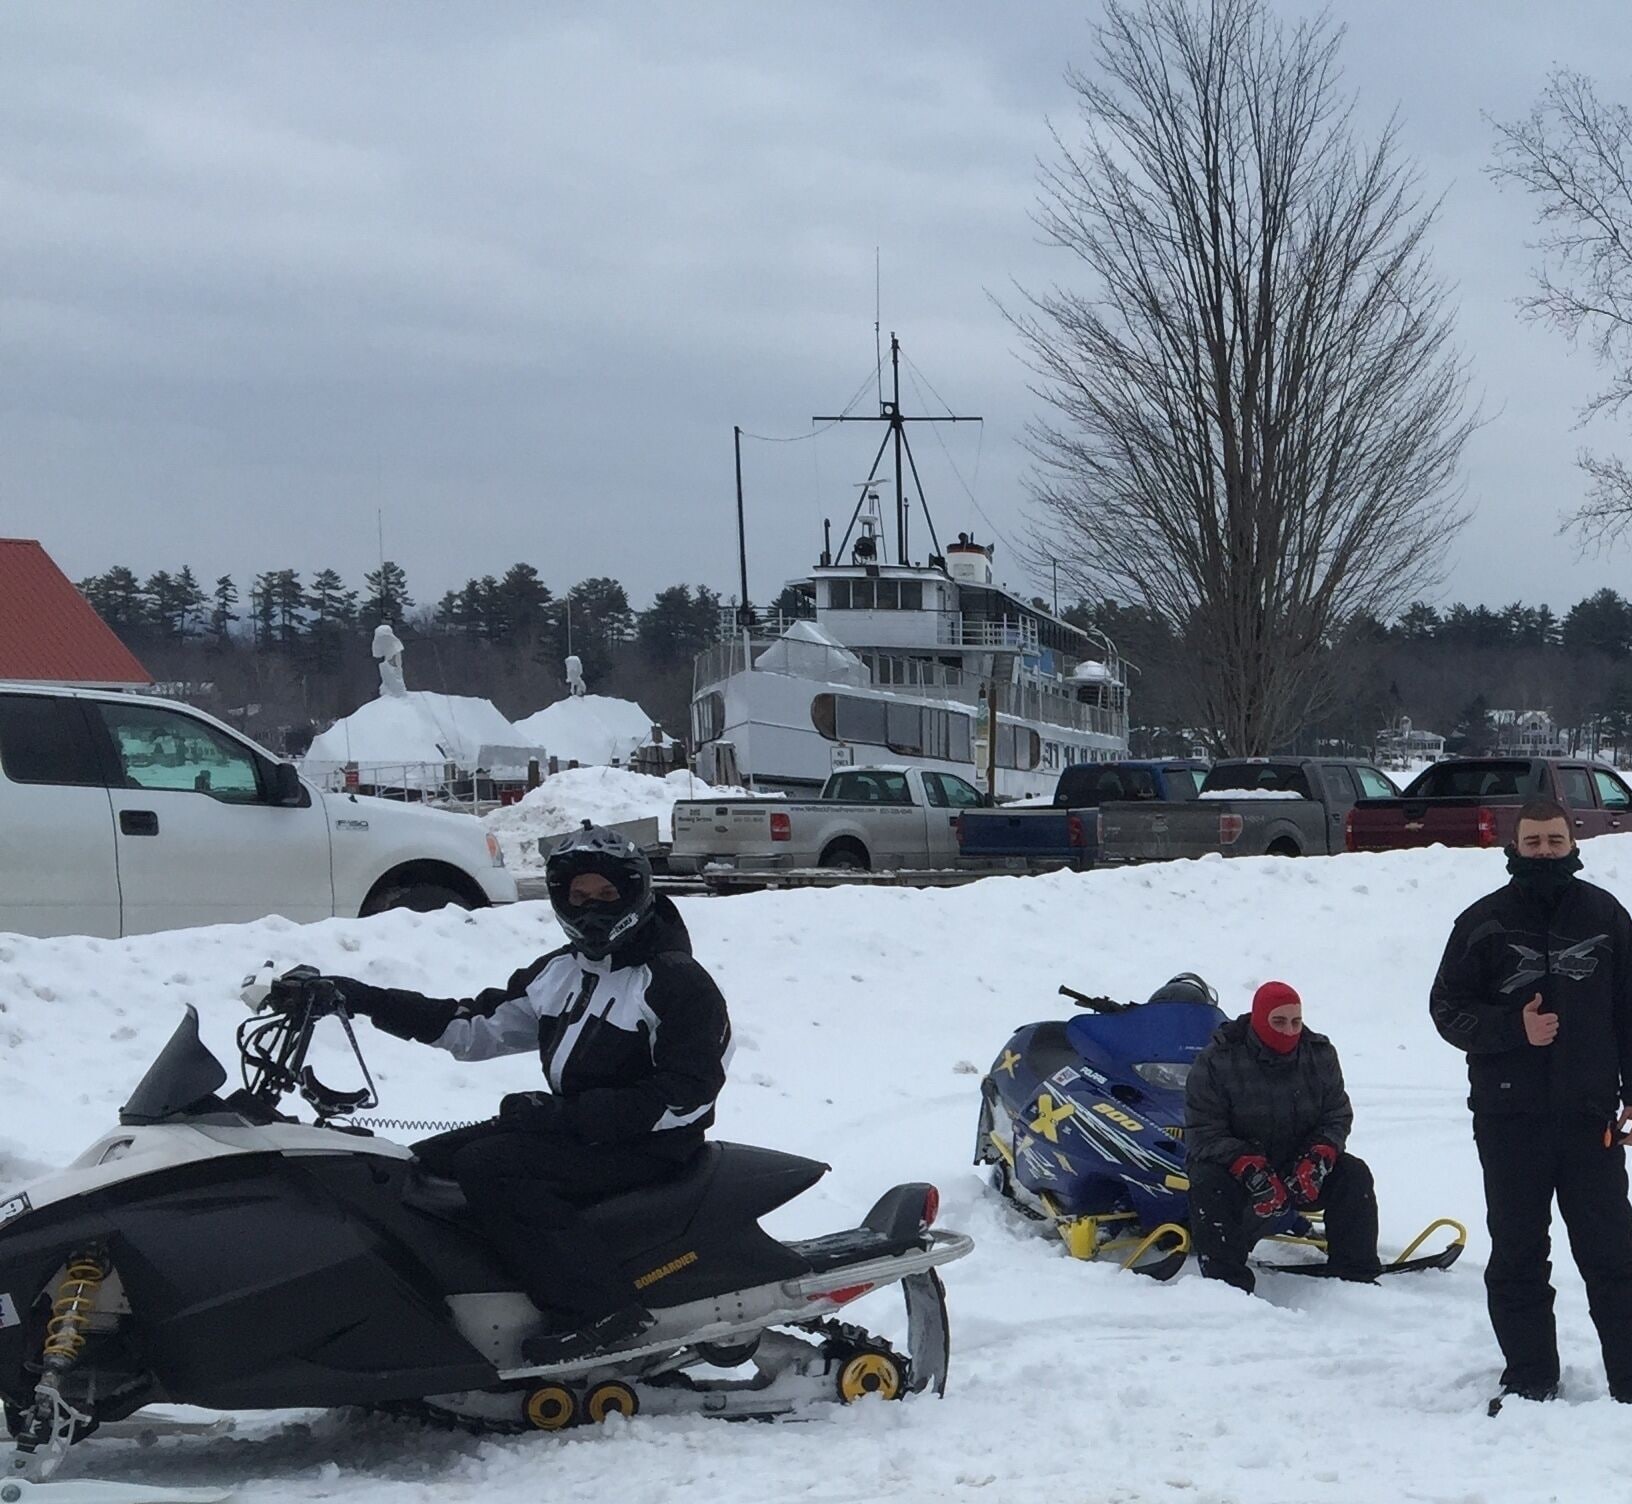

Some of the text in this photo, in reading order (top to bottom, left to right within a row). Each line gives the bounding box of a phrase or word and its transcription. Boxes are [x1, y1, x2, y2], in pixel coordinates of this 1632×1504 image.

[1079, 1066, 1108, 1085] POLARIS
[1091, 1102, 1145, 1132] 800
[633, 1250, 699, 1290] BOMBARDIER
